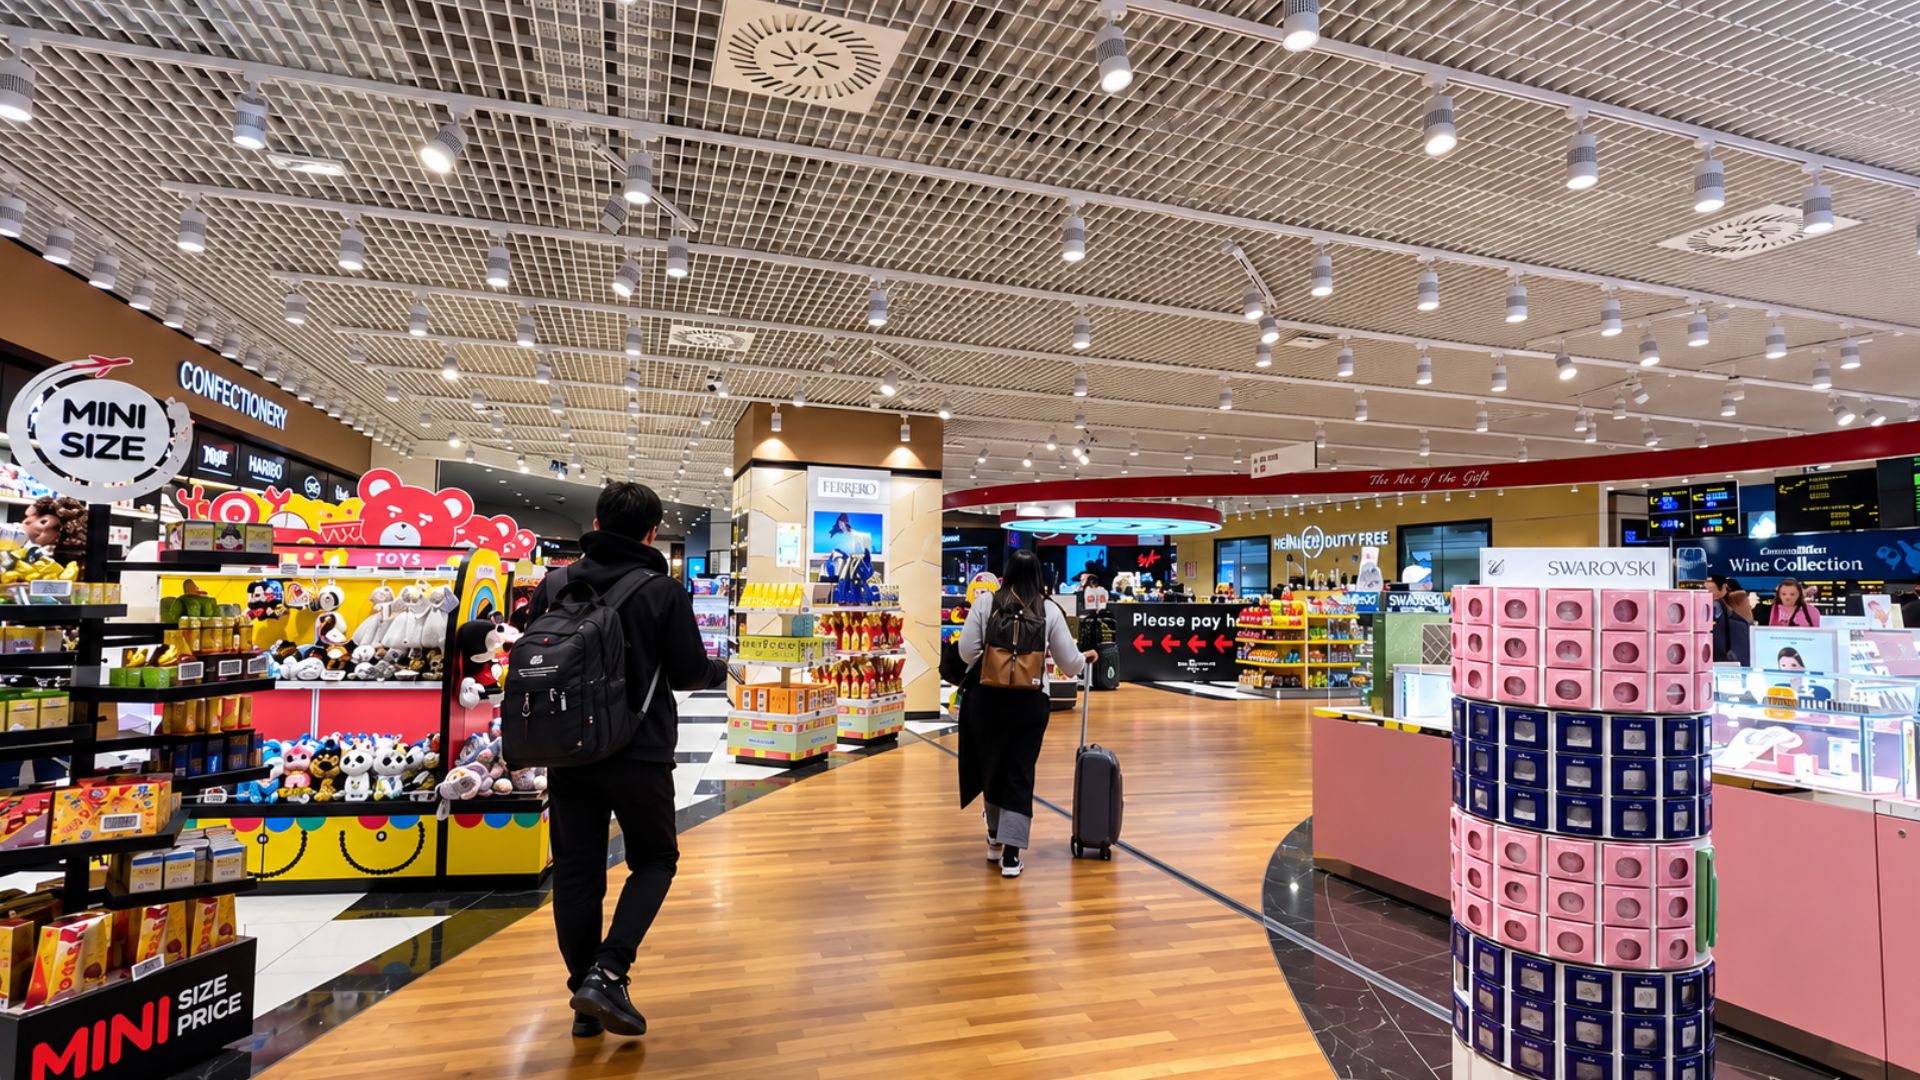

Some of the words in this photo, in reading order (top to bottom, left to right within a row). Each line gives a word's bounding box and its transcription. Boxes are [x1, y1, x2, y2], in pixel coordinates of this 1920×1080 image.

[180, 361, 288, 431] CONFECTIONERY
[63, 398, 146, 428] MINI
[59, 432, 146, 461] SIZE
[248, 454, 283, 480] HARIBO
[823, 480, 877, 497] FERRERO
[1420, 471, 1436, 489] of
[1325, 533, 1356, 549] DUTY
[1358, 530, 1389, 547] FREE
[375, 552, 421, 566] TOYS
[1547, 559, 1656, 577] SWAROVSKI
[1728, 557, 1770, 573] Wine
[1773, 555, 1864, 573] Collection
[1133, 612, 1186, 627] Please
[1191, 616, 1222, 631] pay
[177, 973, 229, 1011] SIZE
[177, 990, 242, 1037] PRICE
[30, 995, 171, 1080] MINI
